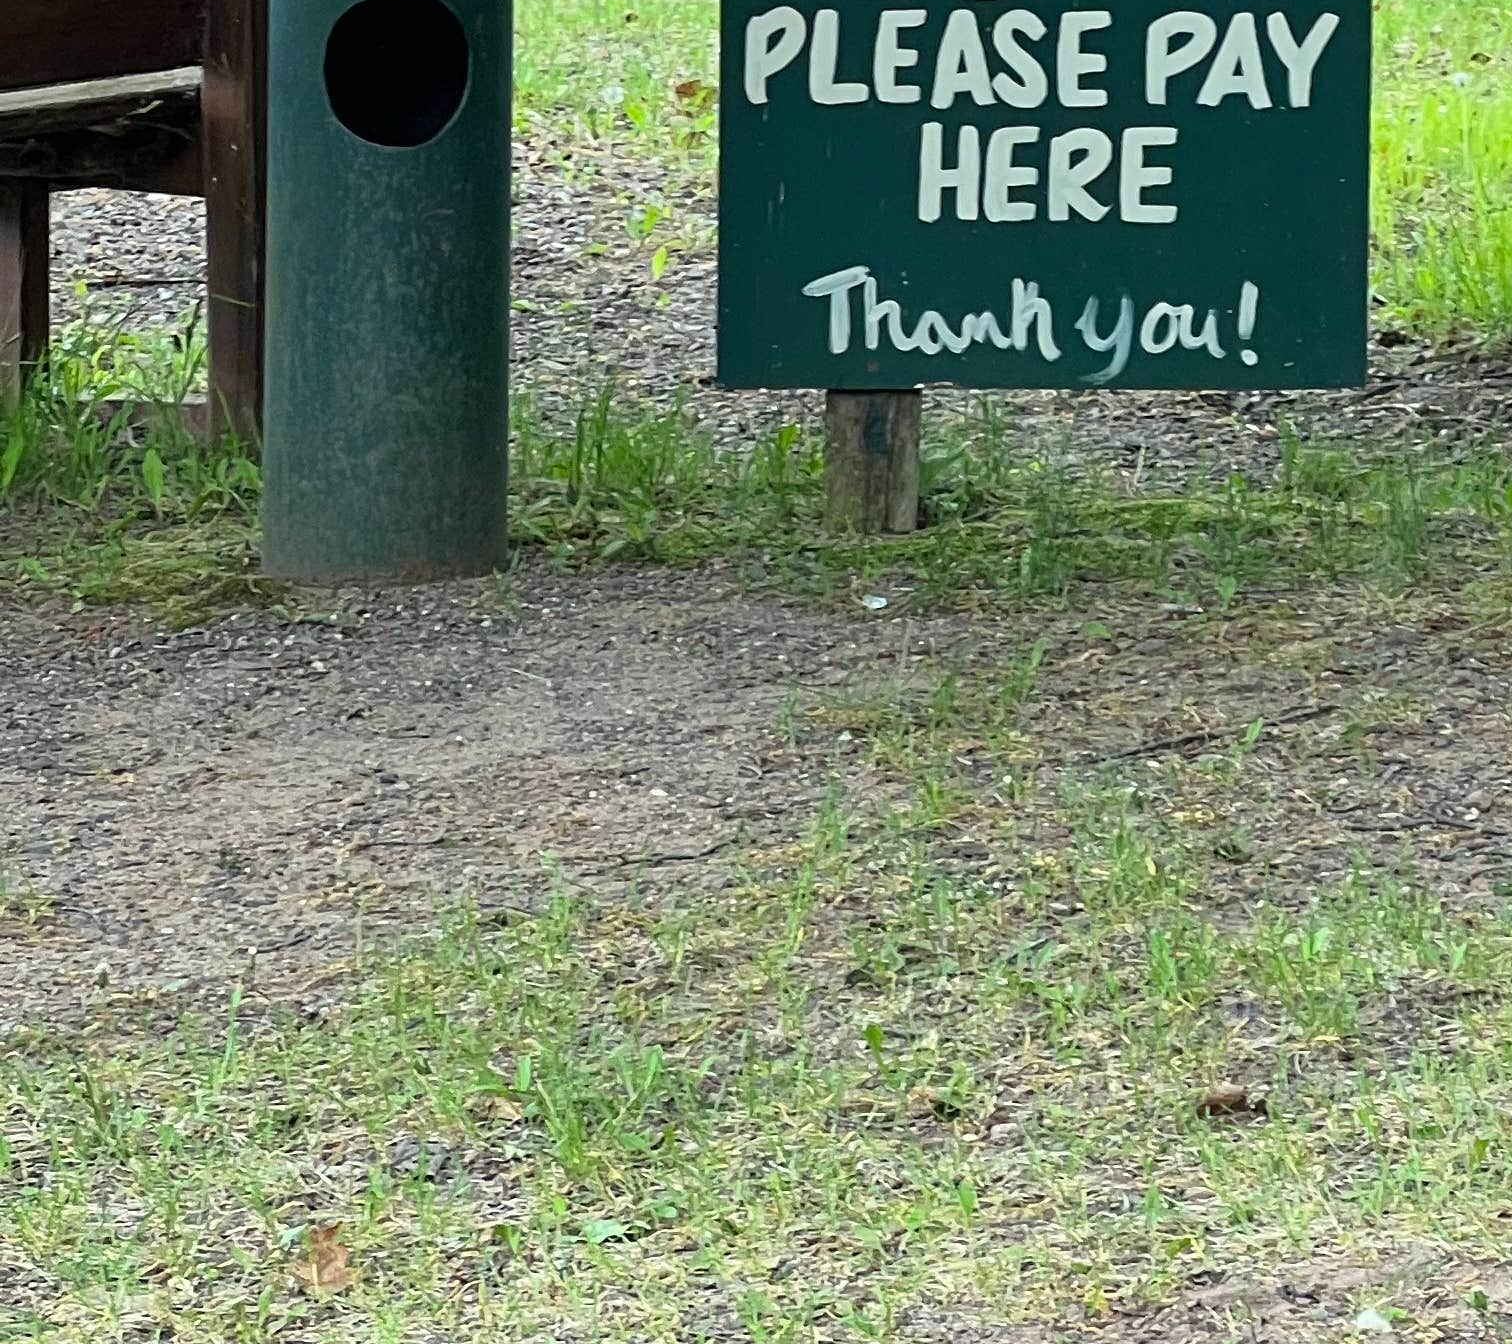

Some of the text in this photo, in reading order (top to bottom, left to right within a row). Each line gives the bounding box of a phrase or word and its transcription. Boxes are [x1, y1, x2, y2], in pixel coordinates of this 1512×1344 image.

[744, 5, 1340, 111] PLEASE PAY
[917, 121, 1179, 225] HERE
[801, 265, 1259, 383] Thank you!
